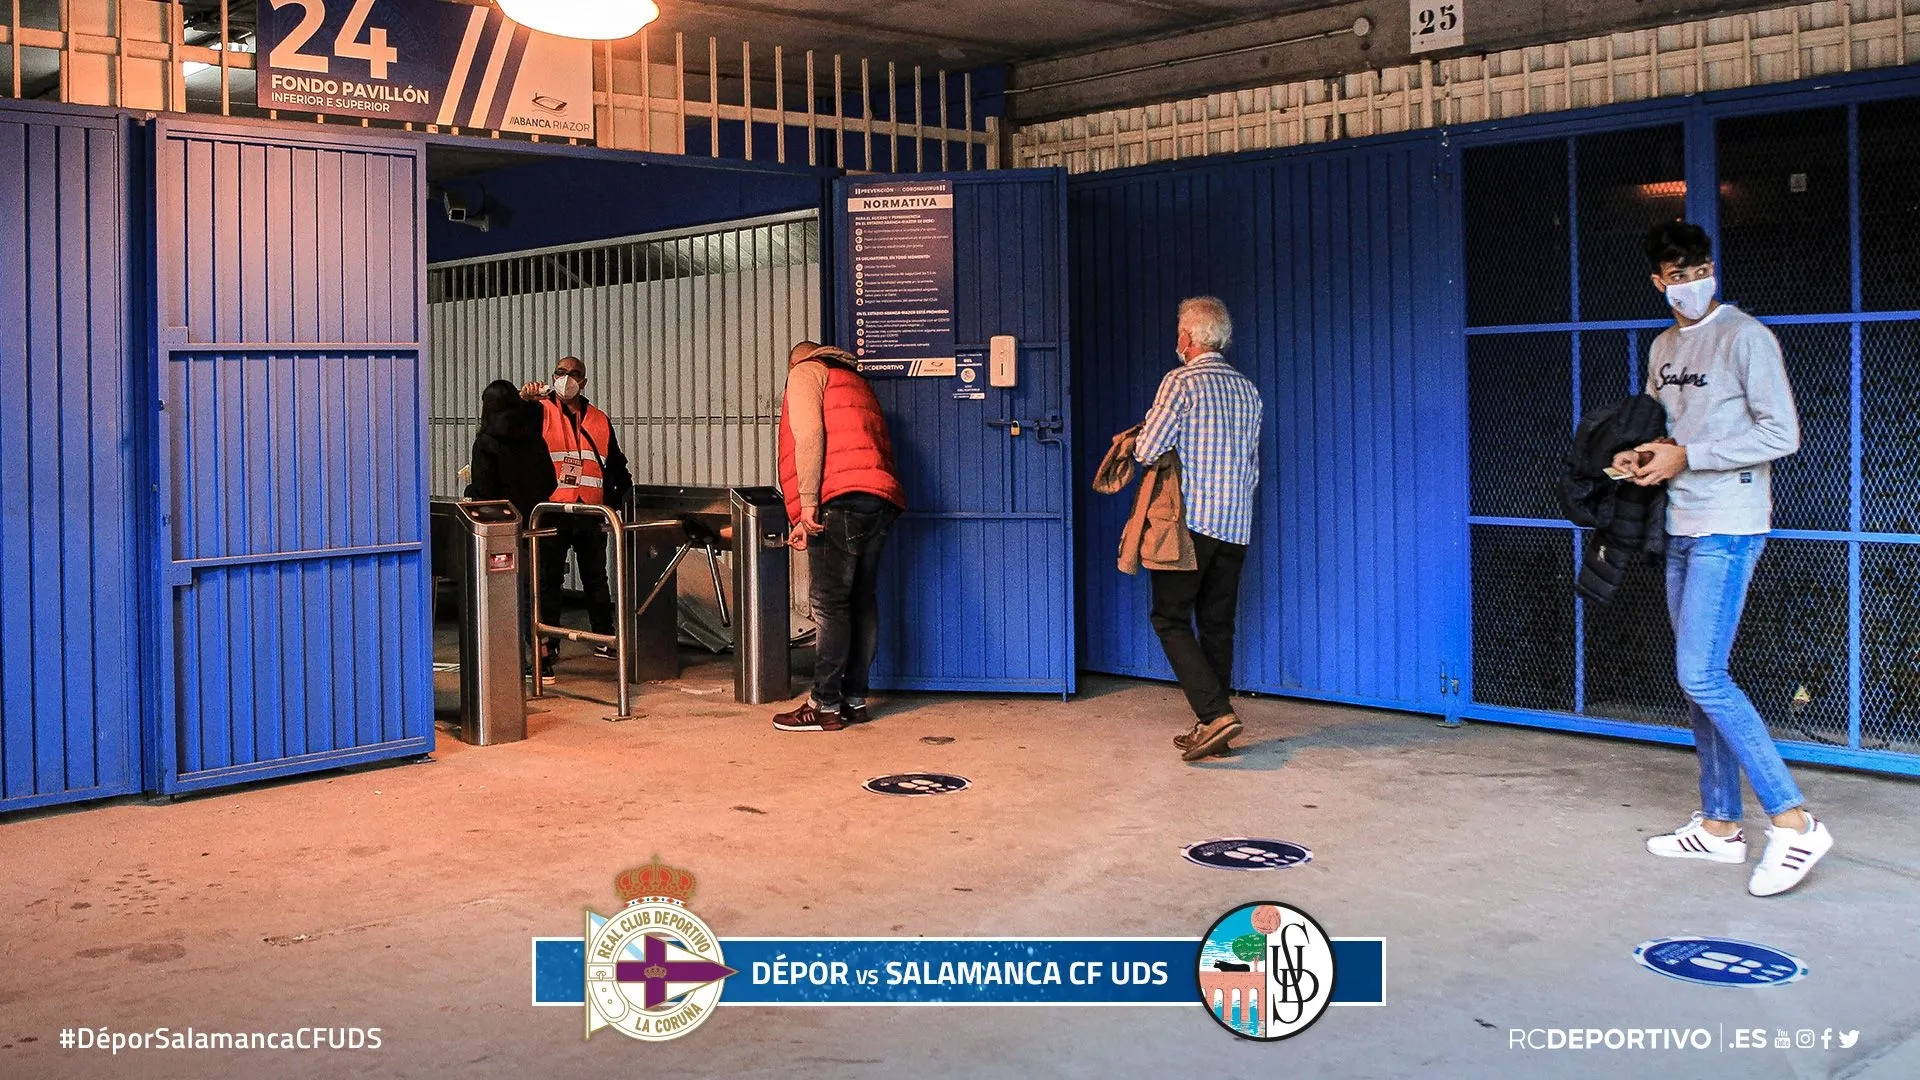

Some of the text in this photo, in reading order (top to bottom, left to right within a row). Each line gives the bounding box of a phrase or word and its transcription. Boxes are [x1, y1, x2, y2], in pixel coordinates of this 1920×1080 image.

[1419, 4, 1457, 35] 25
[270, 0, 398, 80] 24
[272, 74, 429, 104] FONDO PAVILLÓN
[272, 92, 390, 112] INFERIOR E SUPERIOR
[553, 121, 590, 132] RIAZOR
[864, 198, 937, 208] NORMATIVA
